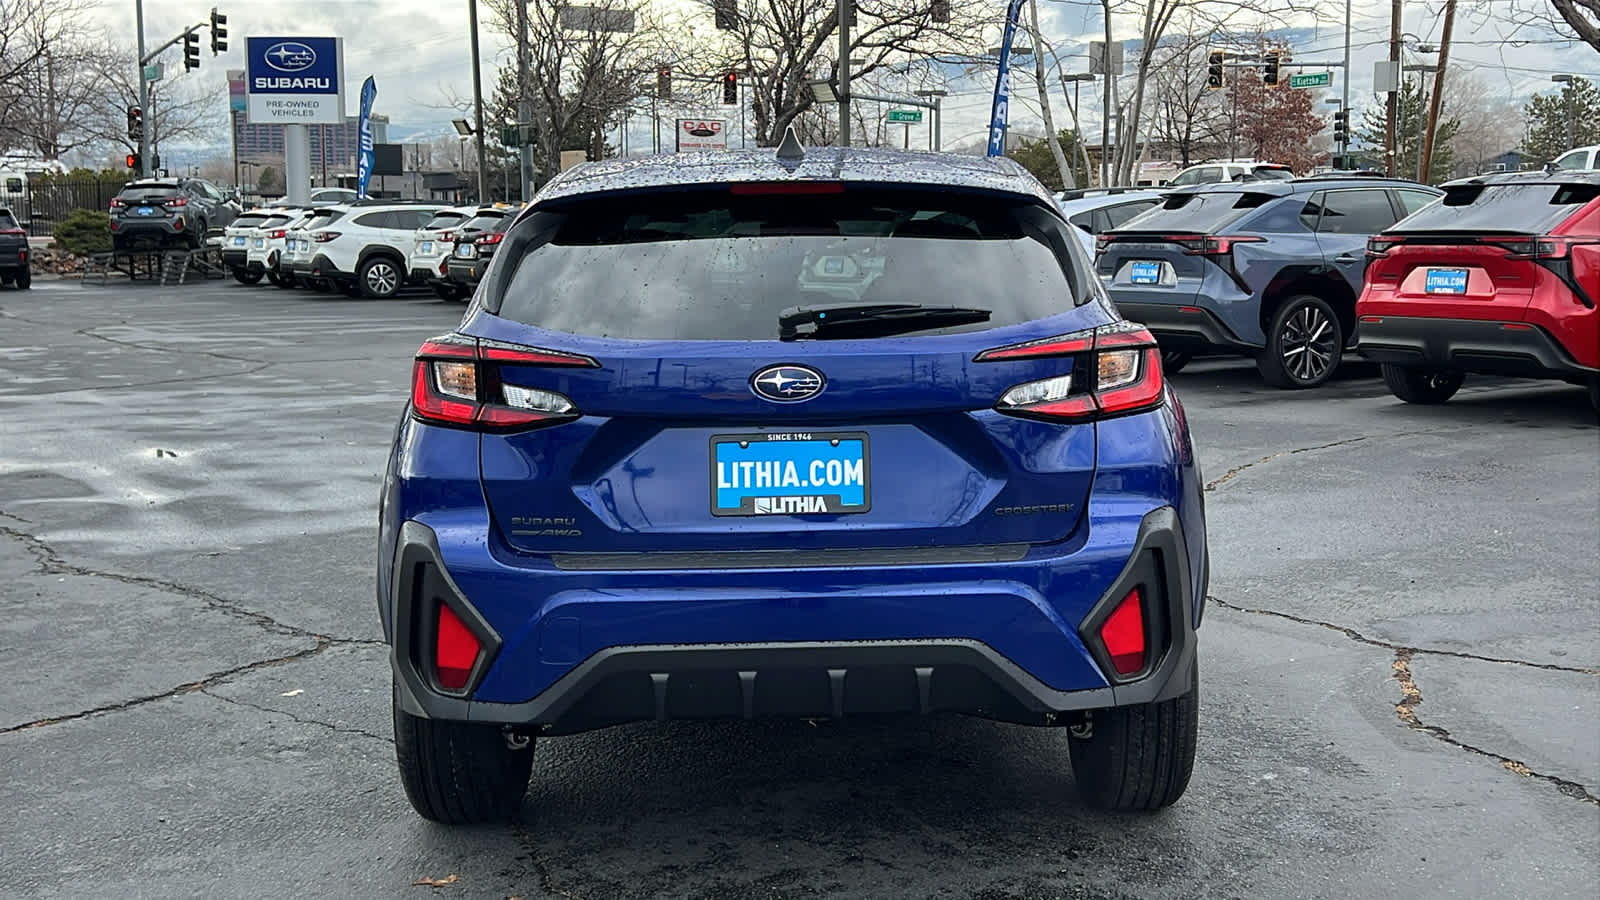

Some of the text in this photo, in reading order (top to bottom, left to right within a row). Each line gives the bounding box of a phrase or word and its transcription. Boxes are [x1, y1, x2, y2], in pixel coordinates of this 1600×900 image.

[255, 77, 330, 89] SUBARU
[266, 100, 320, 109] PRE-OWNED
[272, 109, 315, 118] VEHICLES
[683, 121, 722, 131] CAC
[1427, 276, 1467, 287] LITHIA.COM
[767, 433, 812, 441] SINCE 1946
[717, 458, 864, 489] LITHIA.COM
[771, 496, 828, 514] LITHIA
[994, 503, 1075, 516] CROSSTREK
[511, 516, 576, 526] SUBARU
[541, 529, 582, 537] AWD
